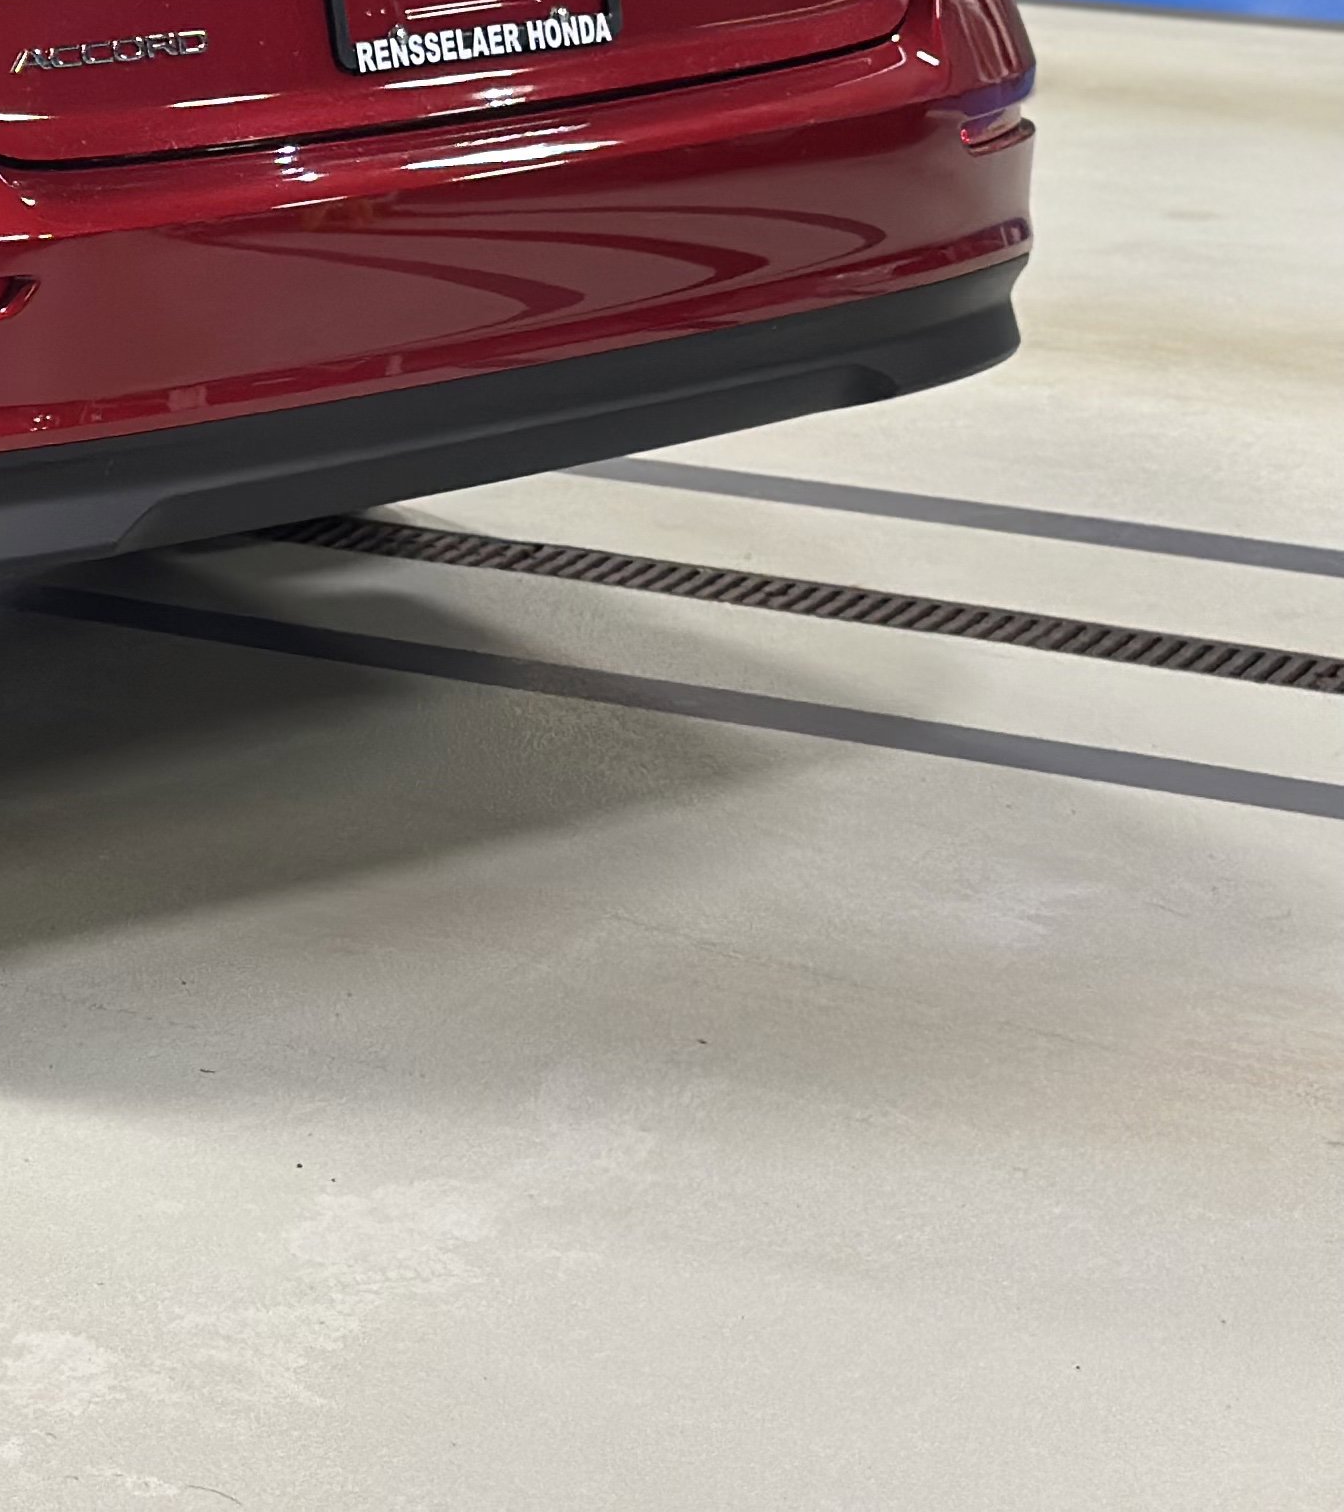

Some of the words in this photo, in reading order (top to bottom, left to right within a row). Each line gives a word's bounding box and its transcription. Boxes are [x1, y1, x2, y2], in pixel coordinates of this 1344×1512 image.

[10, 29, 208, 74] ACCORD
[356, 20, 520, 73] RENSSELAER
[526, 12, 613, 51] HONDA
